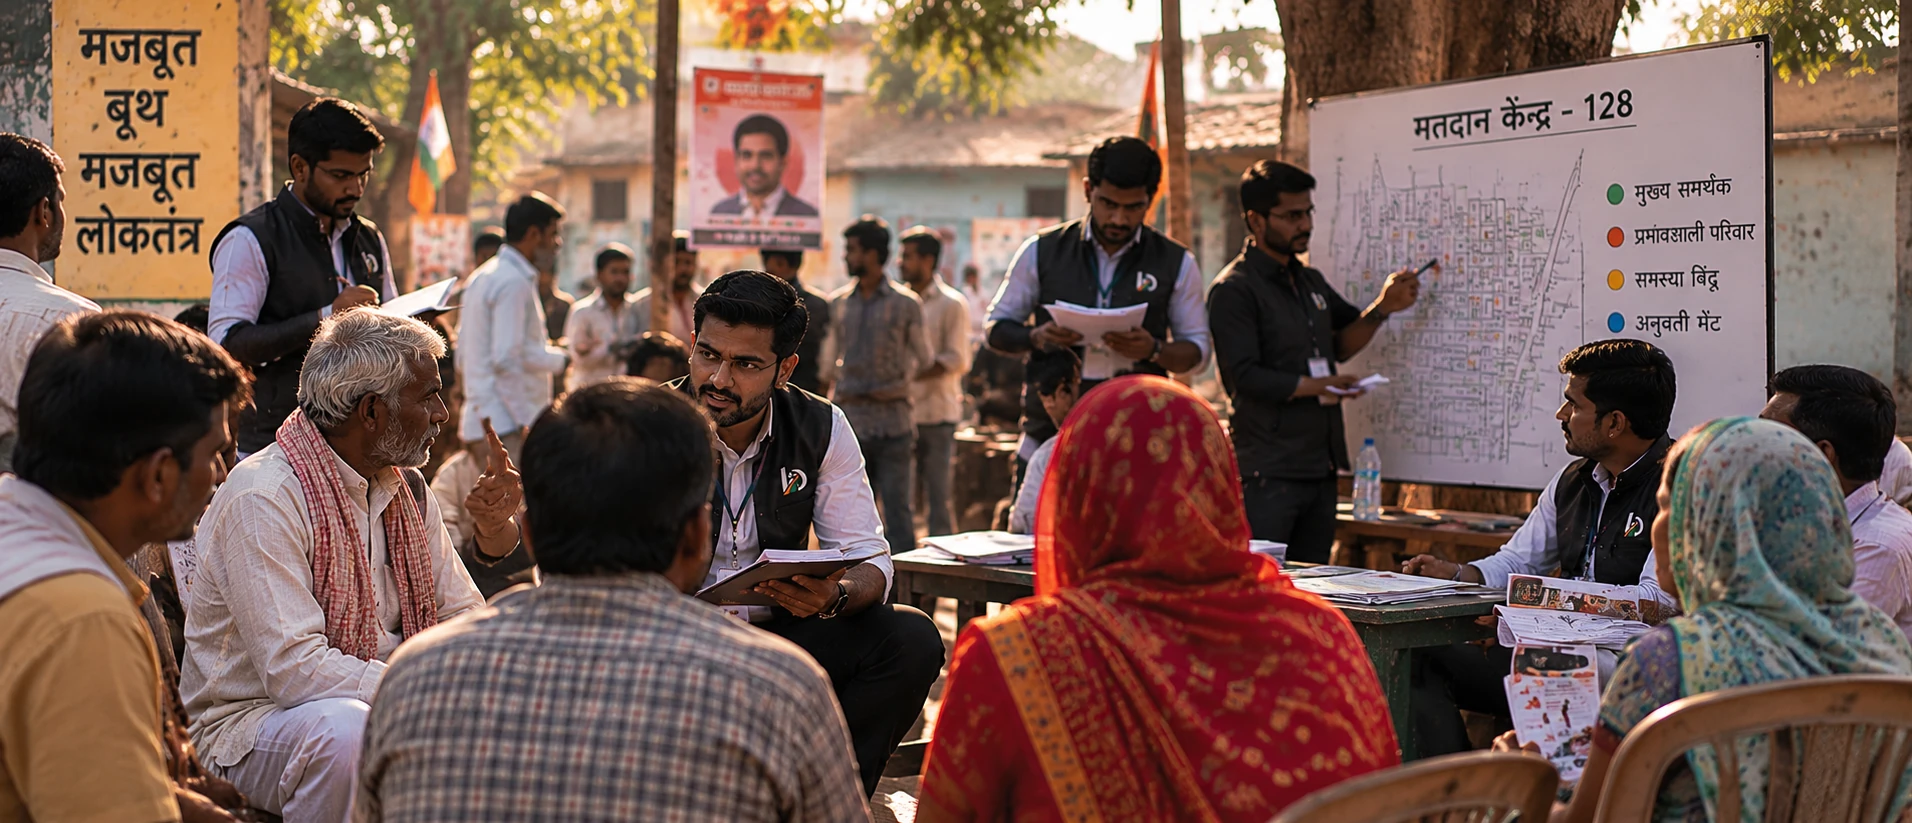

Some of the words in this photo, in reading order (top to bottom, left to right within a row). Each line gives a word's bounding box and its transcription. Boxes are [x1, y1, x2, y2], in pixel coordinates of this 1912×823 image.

[79, 29, 201, 79] मजबूत
[104, 90, 168, 140] बूथ
[1414, 109, 1491, 140] मतदान
[1585, 90, 1632, 121] 128
[79, 154, 200, 203] मजबूत
[1635, 183, 1671, 206] मुख्य
[1677, 173, 1732, 198] समर्थक
[75, 204, 204, 254] लोकतंत्र
[1709, 219, 1755, 241] परिवार
[1635, 272, 1684, 288] समस्या
[1636, 310, 1690, 337] अनुवती
[1697, 310, 1721, 331] मेंट
